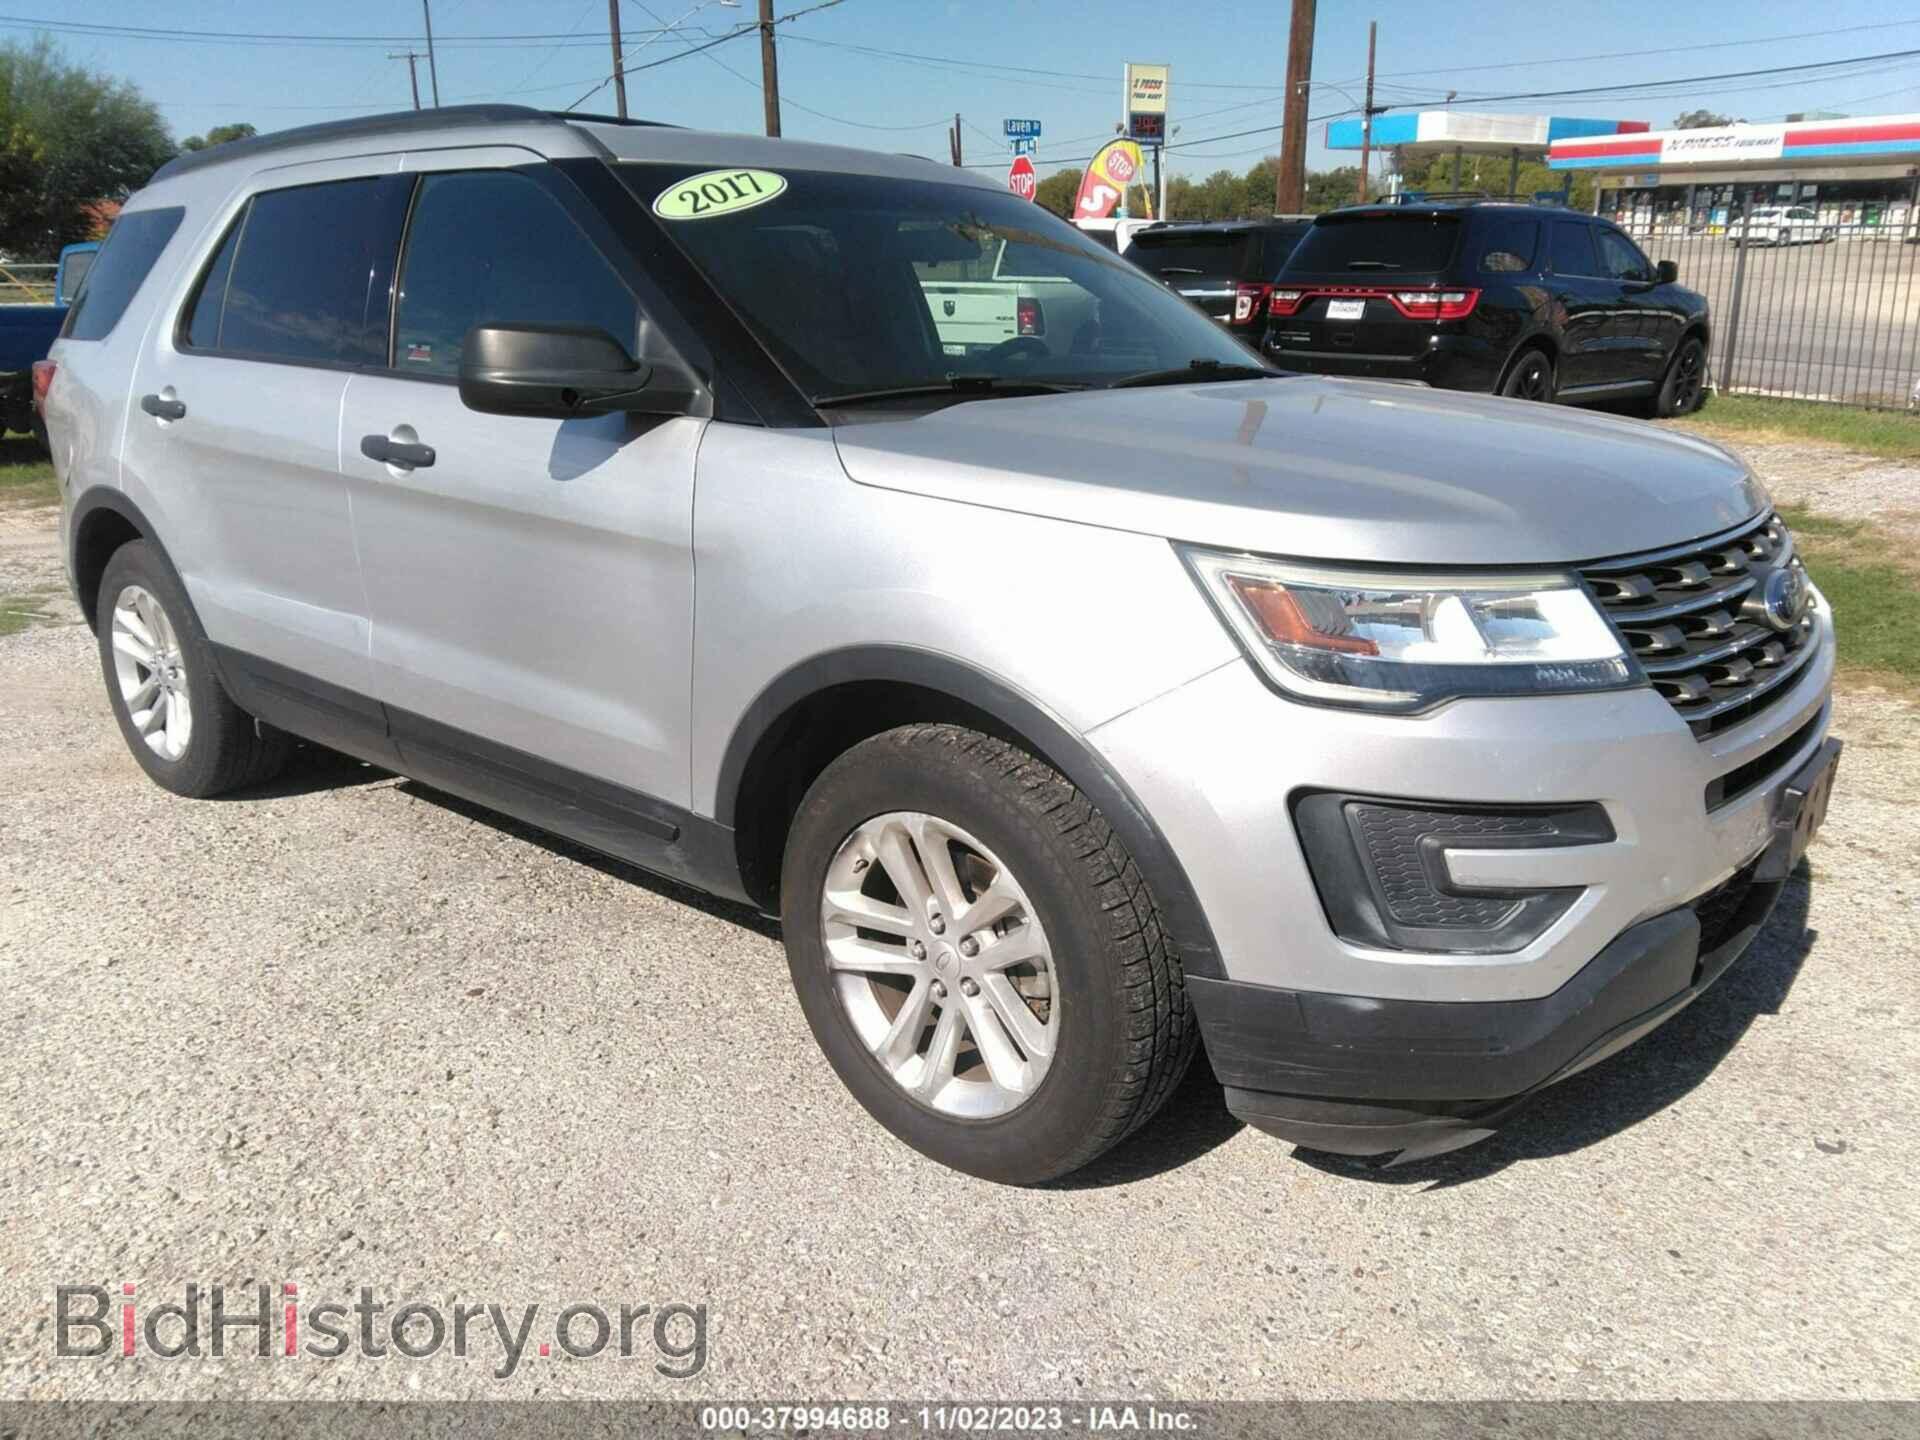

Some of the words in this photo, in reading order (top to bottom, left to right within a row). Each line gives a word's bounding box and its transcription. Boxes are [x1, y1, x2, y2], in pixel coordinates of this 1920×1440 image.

[1007, 120, 1031, 132] Laven
[1108, 151, 1133, 176] STOP
[678, 172, 763, 214] 2017
[1010, 173, 1033, 194] STOP
